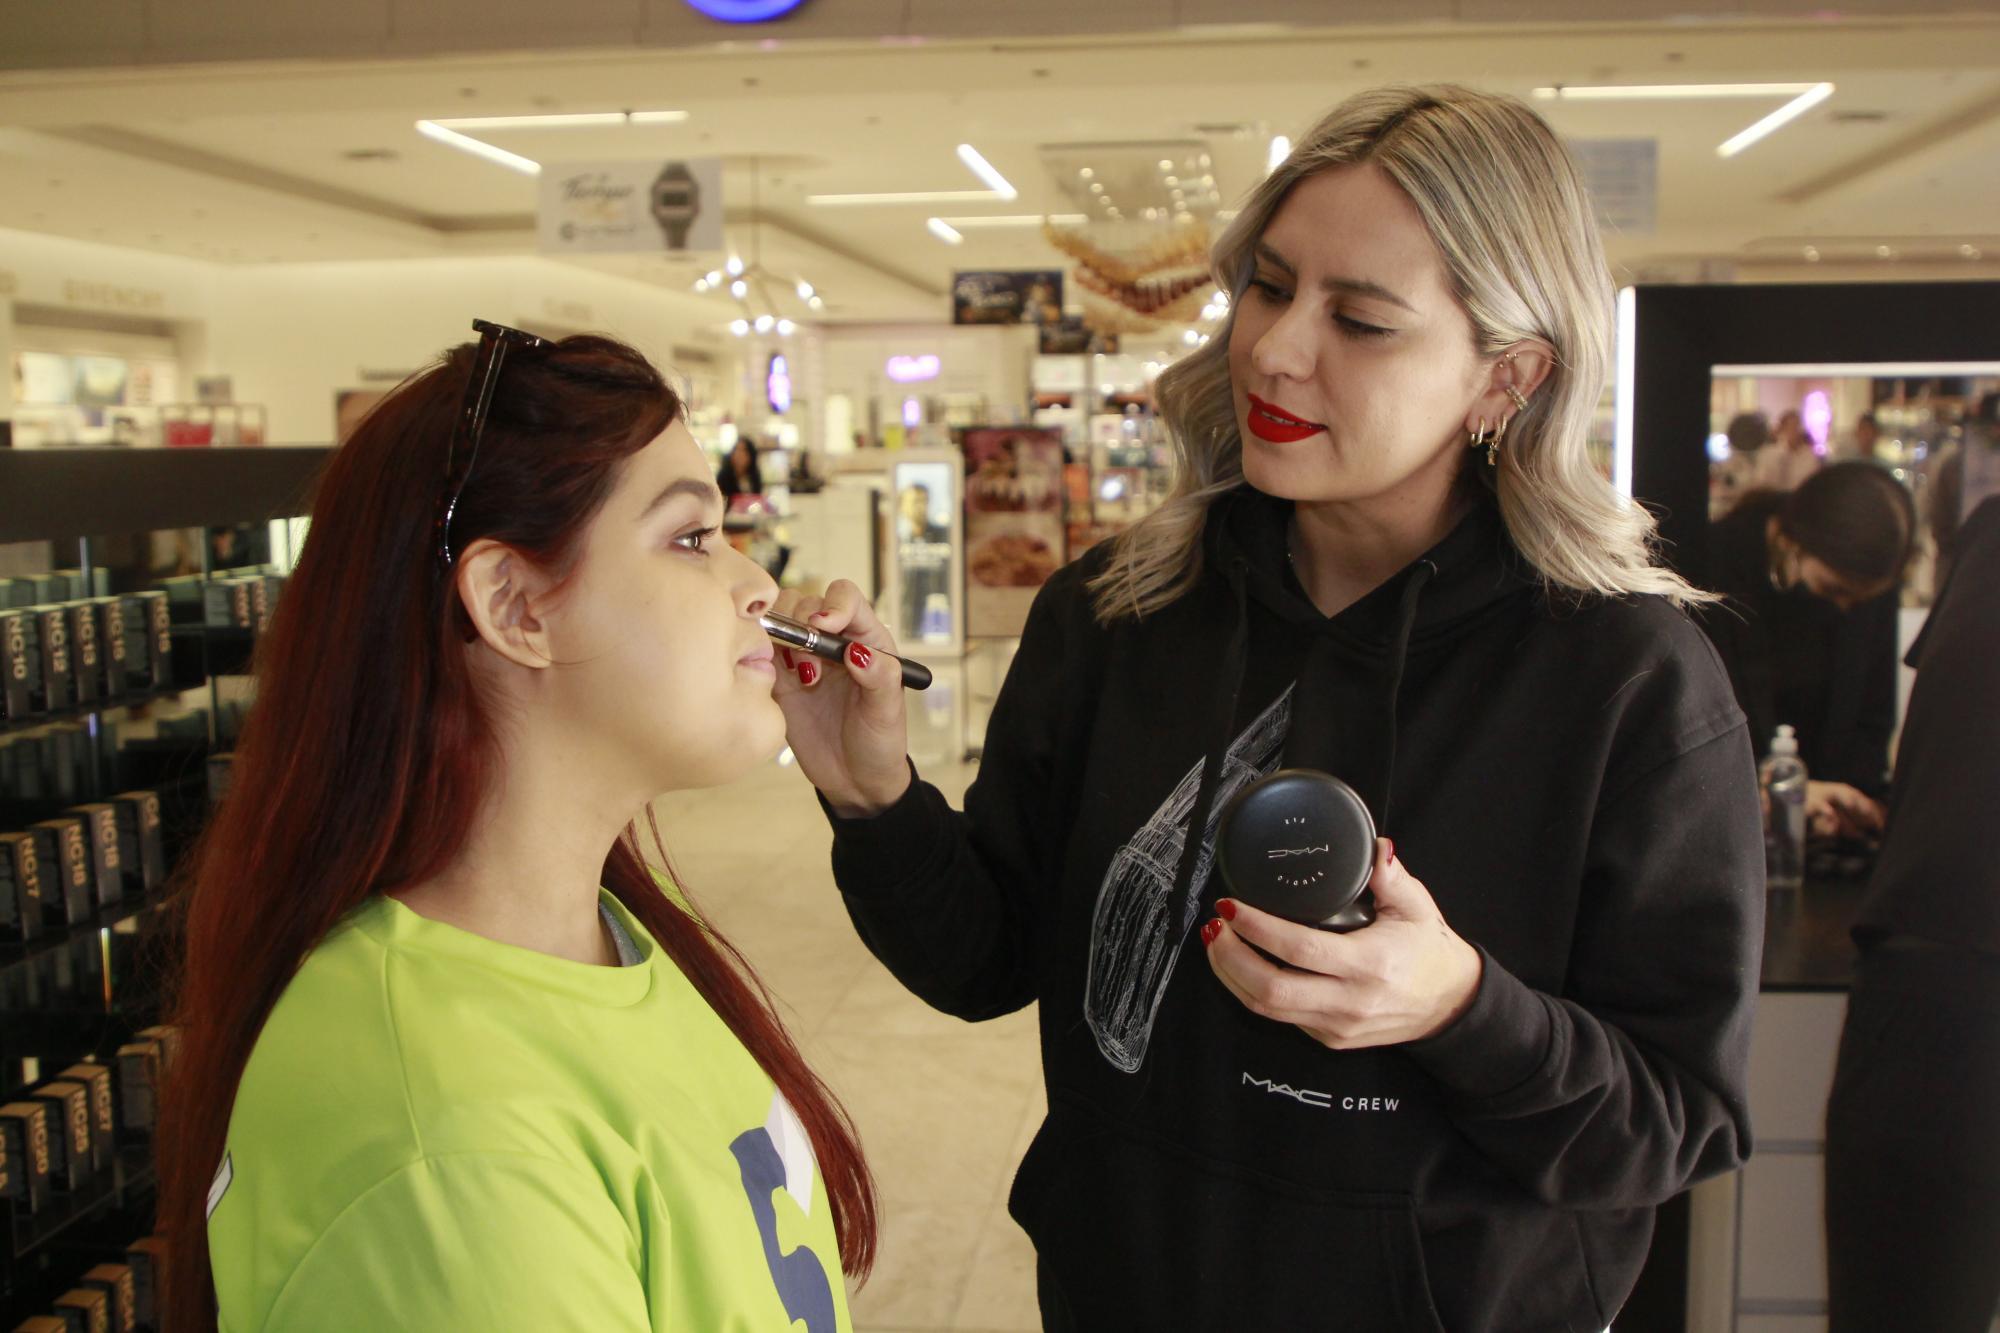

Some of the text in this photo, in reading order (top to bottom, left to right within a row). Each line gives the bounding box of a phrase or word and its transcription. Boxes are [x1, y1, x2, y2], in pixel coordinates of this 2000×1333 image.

[9, 616, 27, 680] NC10
[50, 611, 68, 673] NC12
[1242, 1071, 1400, 1112] MAC CREW
